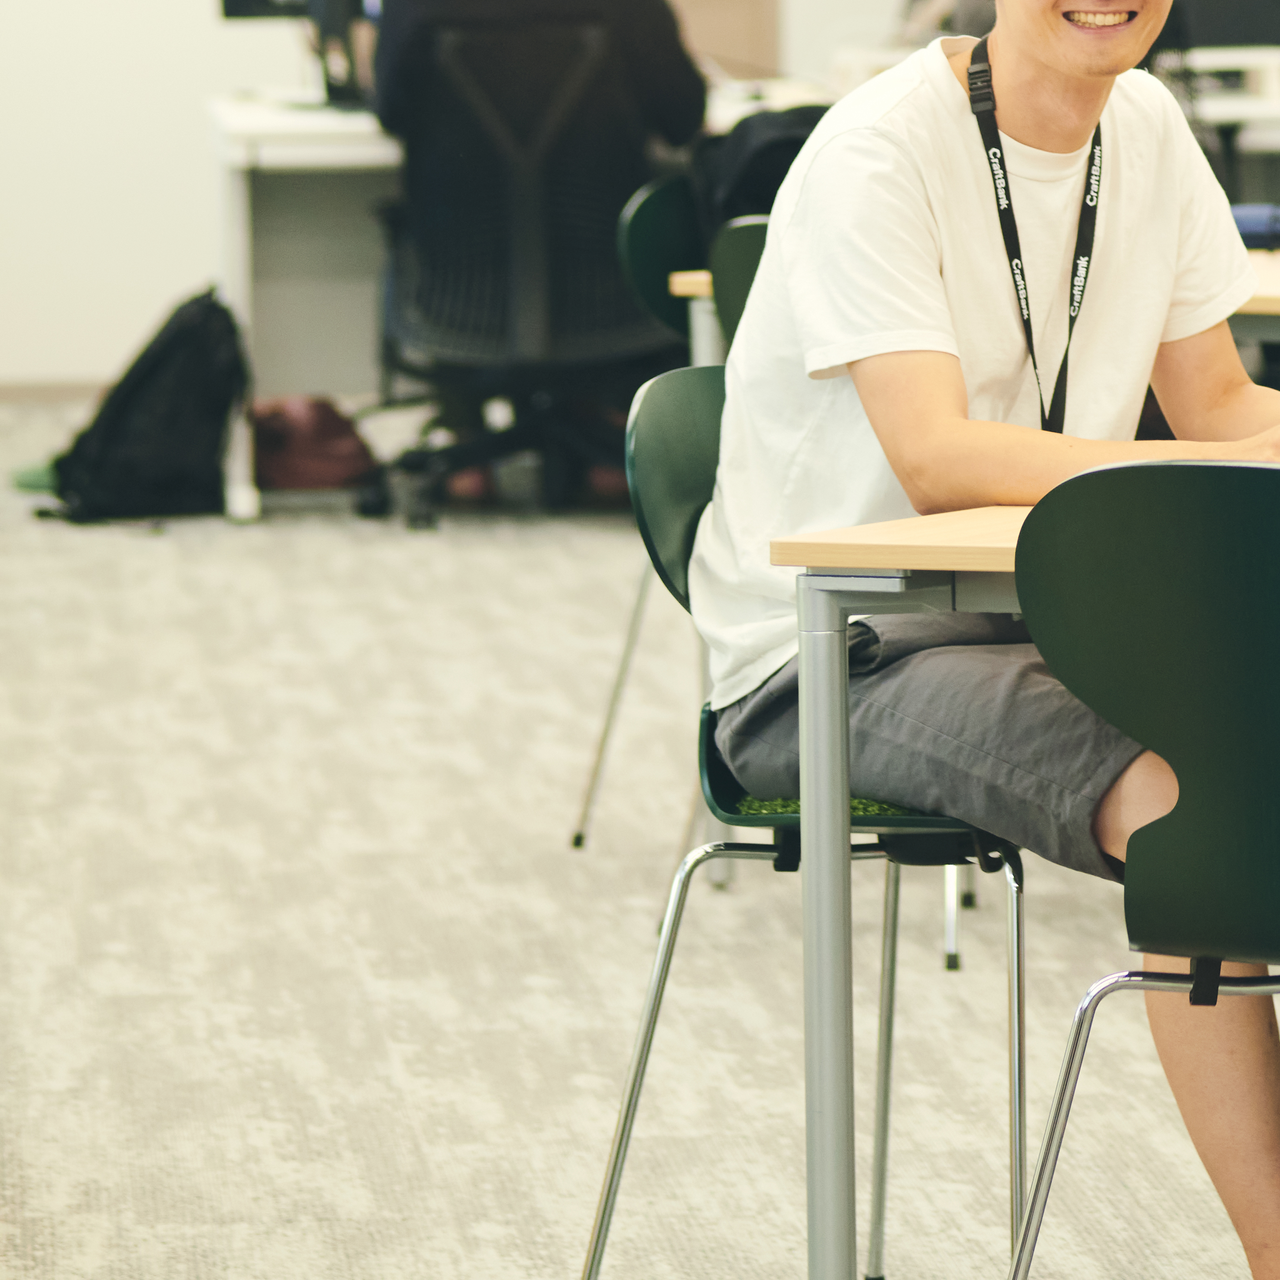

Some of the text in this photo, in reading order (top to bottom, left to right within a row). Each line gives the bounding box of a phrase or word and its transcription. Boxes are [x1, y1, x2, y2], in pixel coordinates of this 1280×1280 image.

[988, 147, 1009, 210] CraftBank
[1086, 145, 1102, 207] CraftBank
[1012, 258, 1029, 320] CraftBank
[1070, 256, 1089, 317] CraftBank
